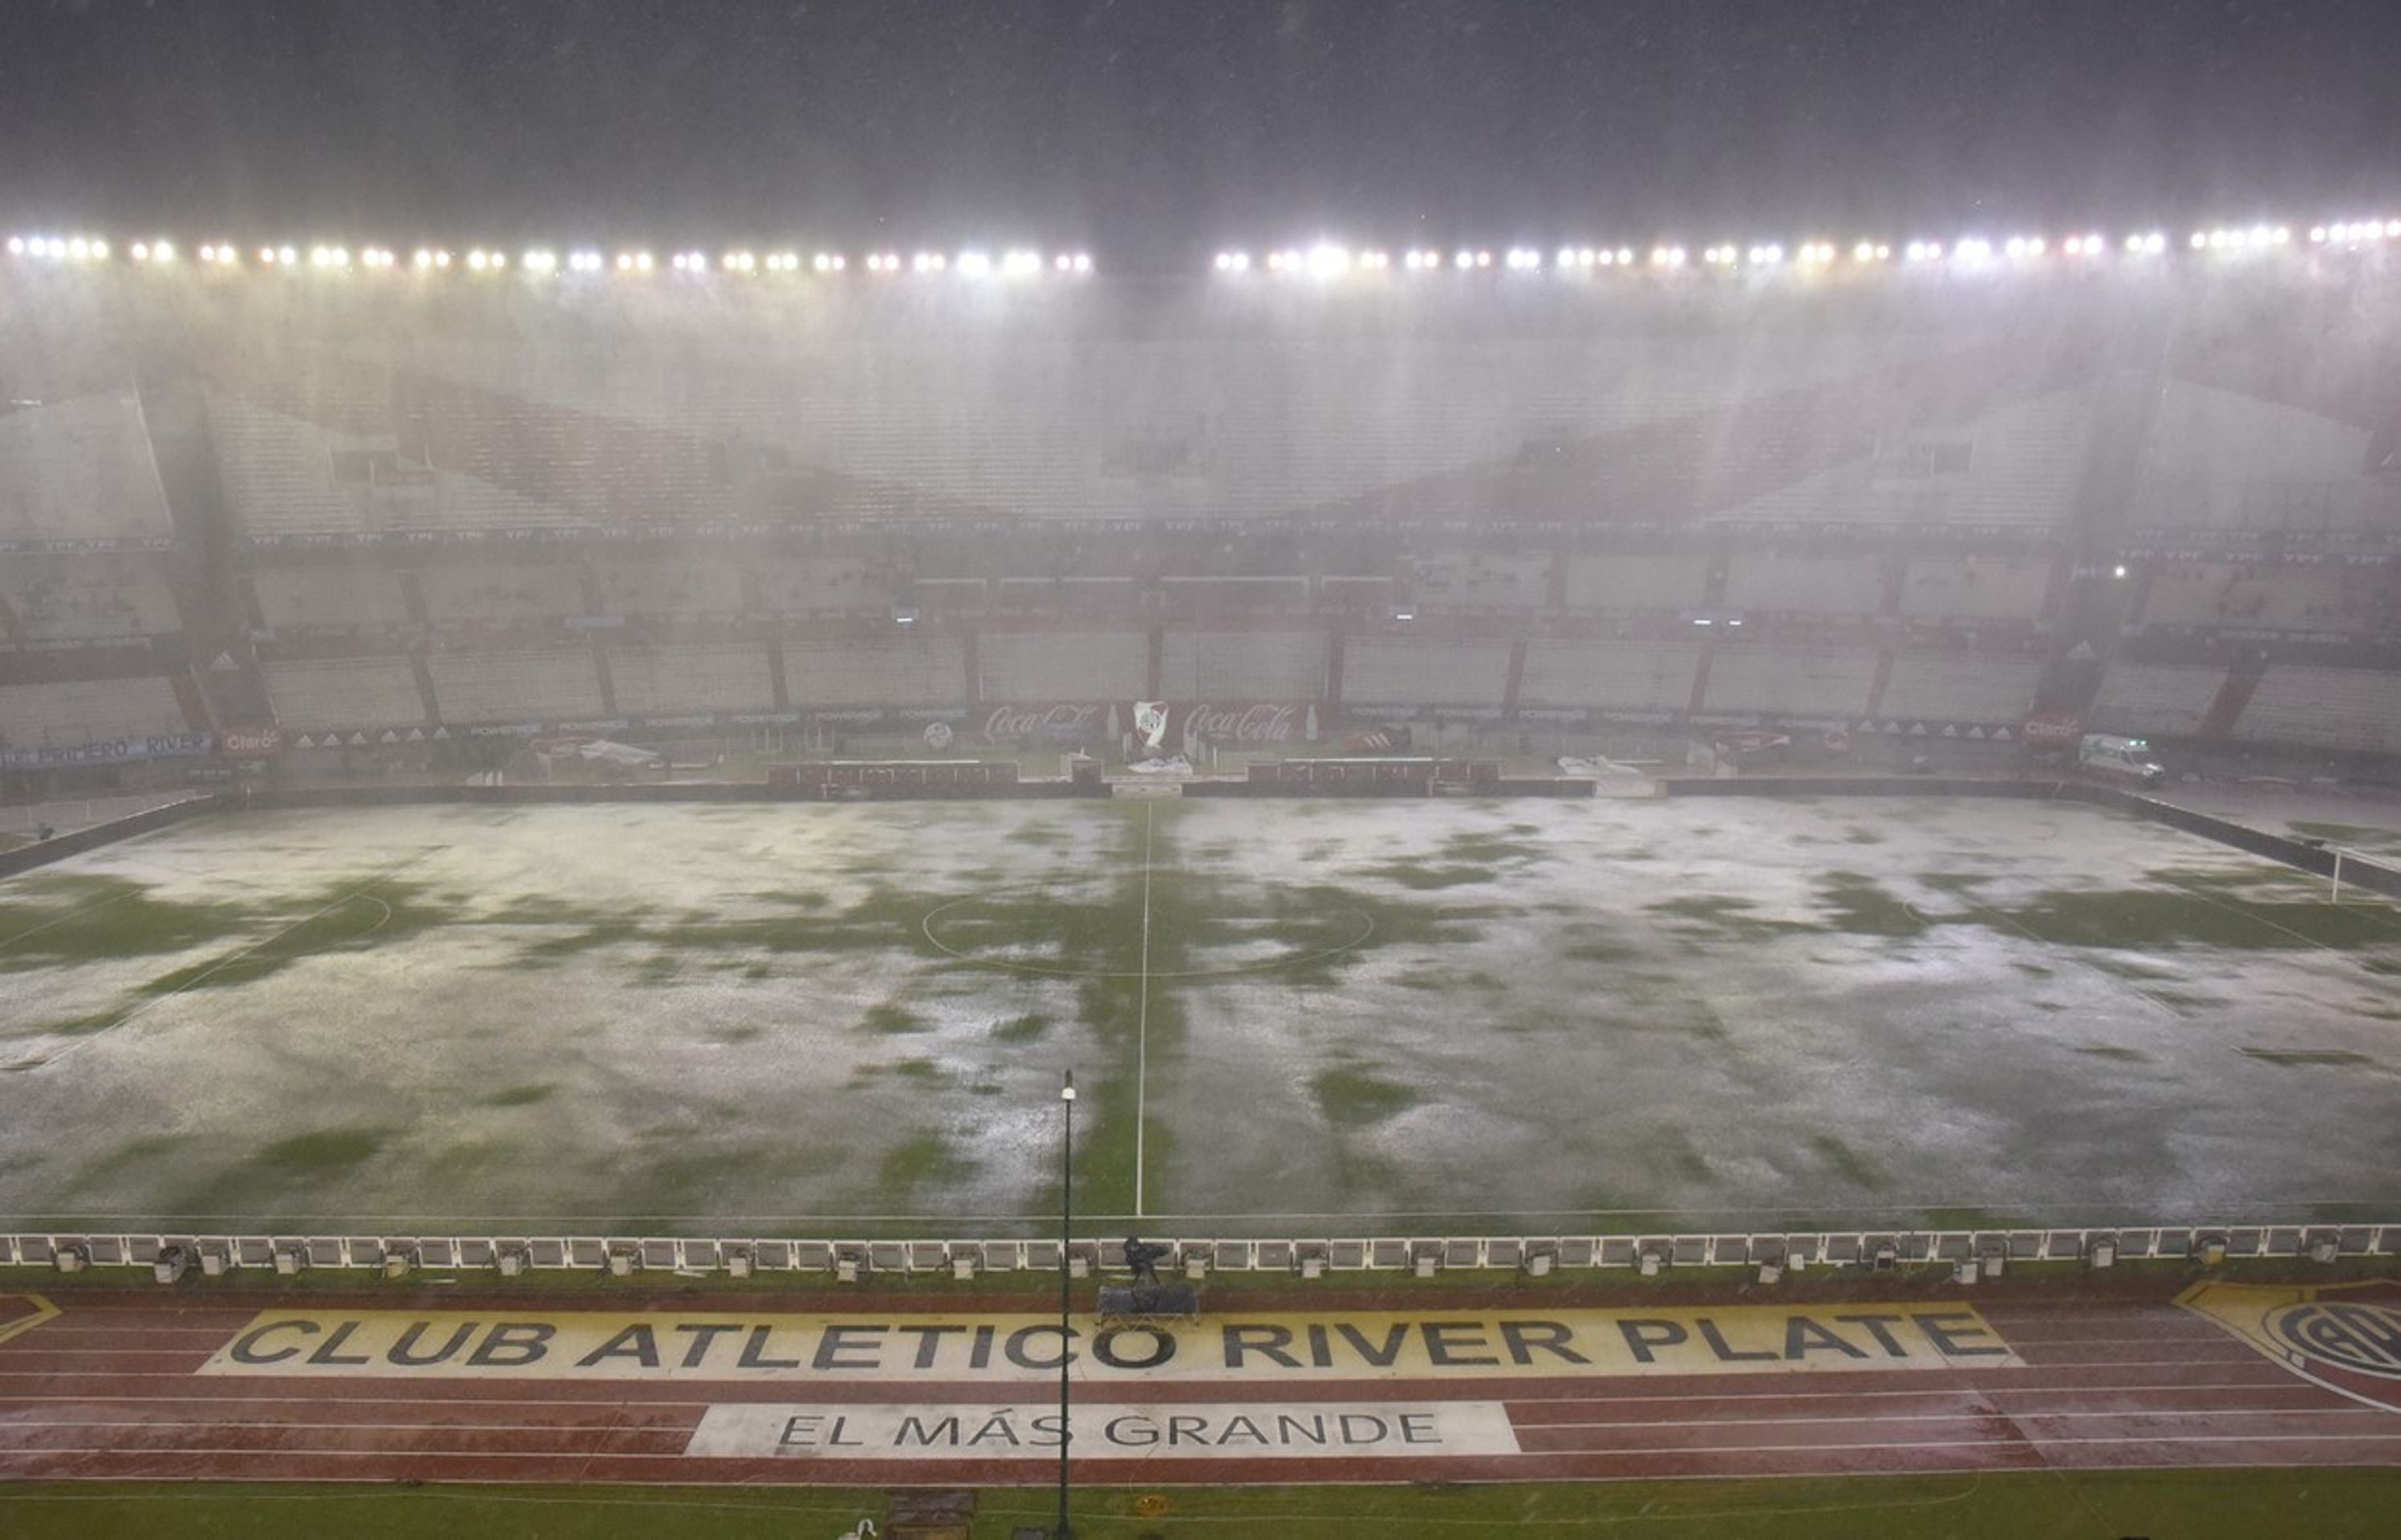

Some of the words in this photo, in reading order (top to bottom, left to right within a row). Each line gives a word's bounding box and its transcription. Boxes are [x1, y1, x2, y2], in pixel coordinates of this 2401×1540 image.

[1183, 704, 1297, 740] Coca-Cola
[38, 740, 128, 762] PRIMERO
[146, 735, 204, 755] RIVER
[227, 733, 274, 751] Claro
[229, 1319, 558, 1366] CLUB
[576, 1323, 1178, 1369] ATLETICO
[1222, 1319, 1594, 1368] RIVER
[1616, 1312, 2010, 1364] PLATE
[778, 1415, 864, 1446] EL
[892, 1408, 1075, 1446] MÁS
[1104, 1413, 1444, 1446] GRANDE
